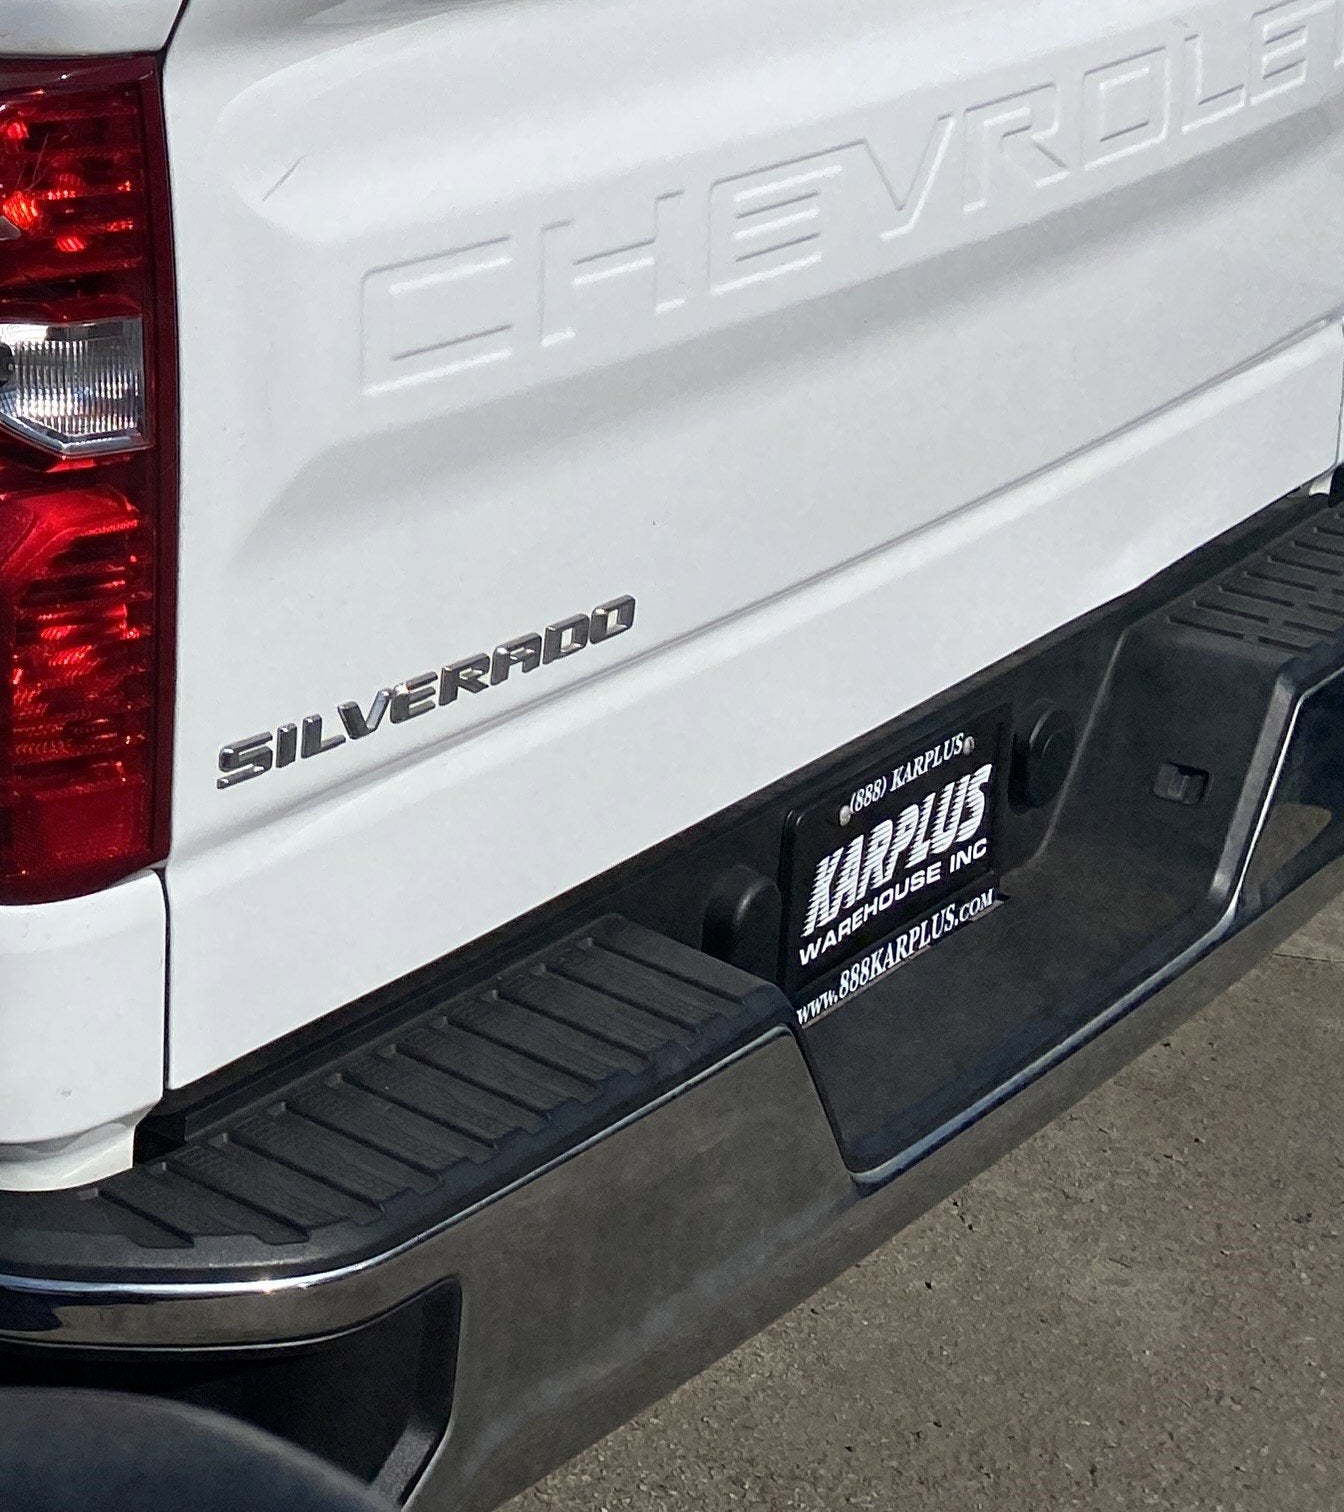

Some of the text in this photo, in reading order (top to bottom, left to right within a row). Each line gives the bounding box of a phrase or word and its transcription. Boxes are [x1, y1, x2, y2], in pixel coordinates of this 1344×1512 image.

[217, 594, 636, 790] SILVERADO
[850, 732, 965, 813] (888) KARPLUS
[799, 838, 988, 966] WAREHOUSE INC
[800, 763, 993, 938] KARPLUS
